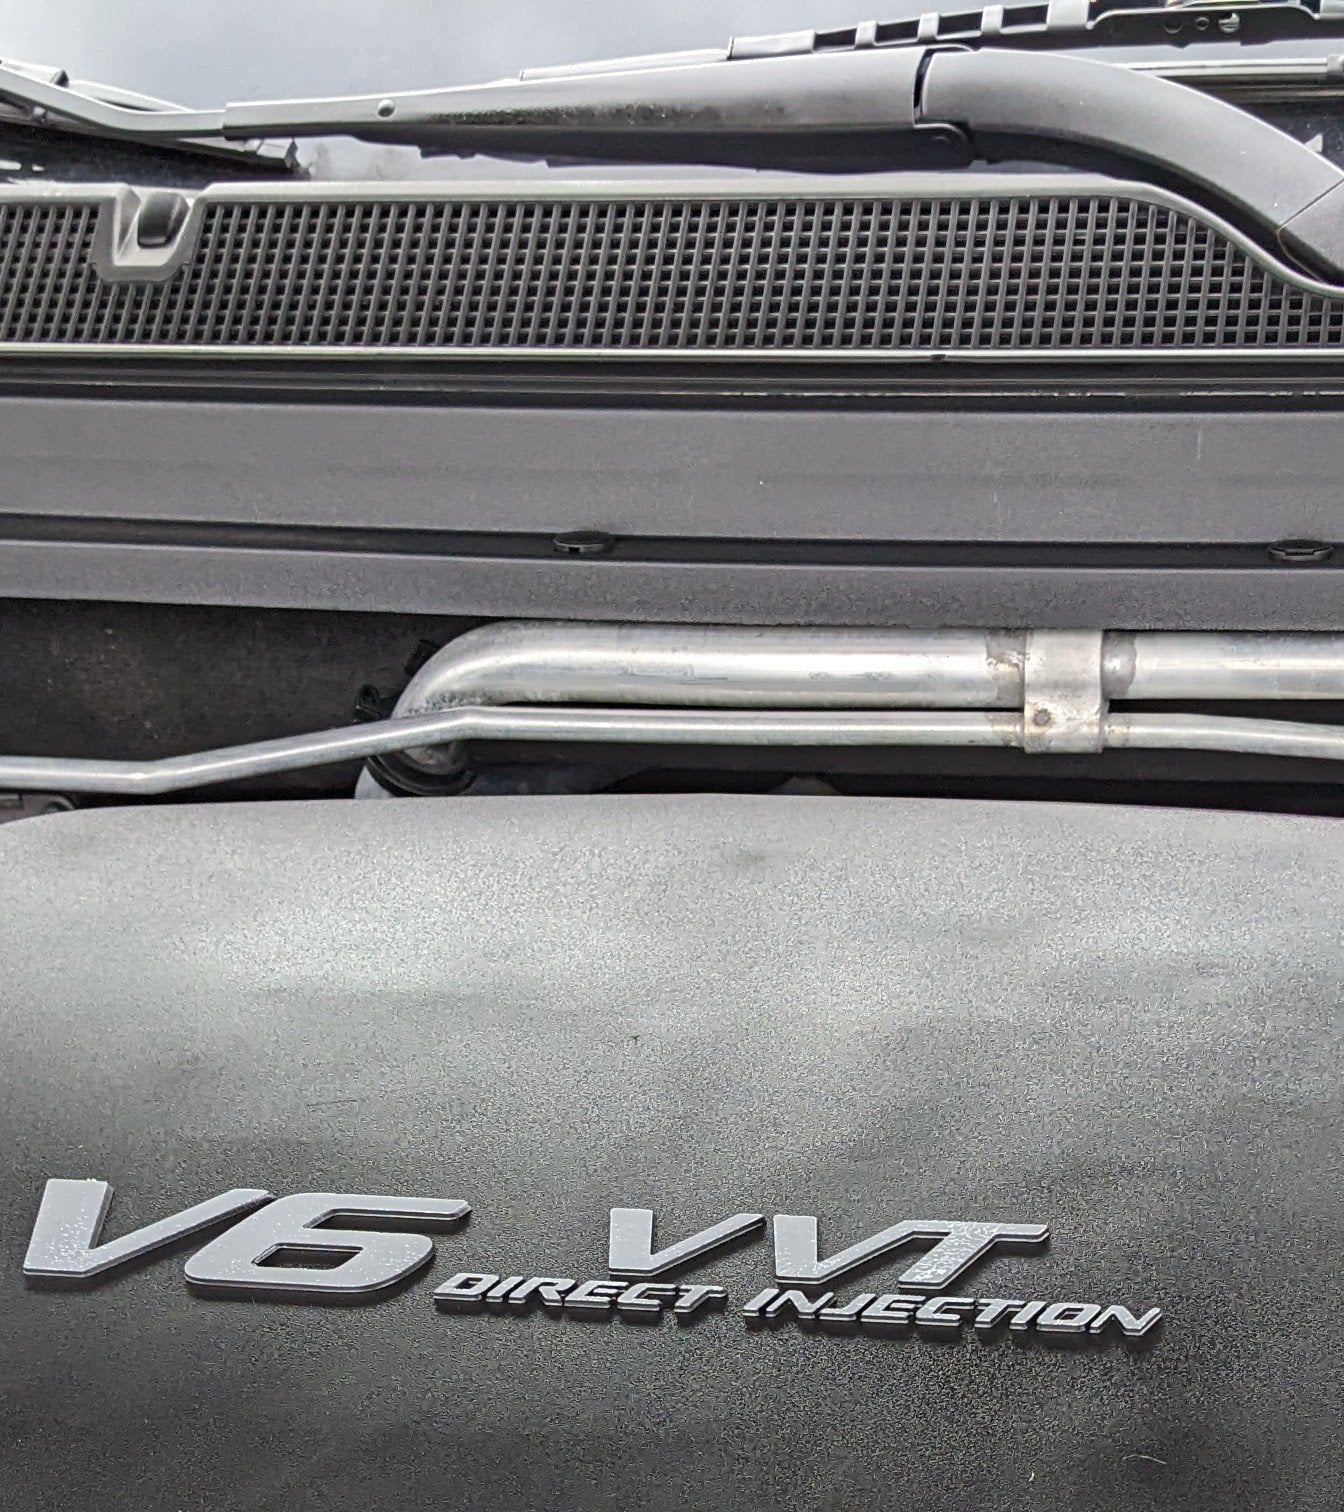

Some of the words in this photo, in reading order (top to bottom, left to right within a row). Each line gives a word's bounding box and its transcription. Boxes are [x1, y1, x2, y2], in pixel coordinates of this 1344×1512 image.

[22, 1178, 472, 1293] V6
[609, 1207, 1050, 1290] VVT
[433, 1272, 729, 1315] DIRECT
[744, 1288, 1163, 1336] INJECTION
